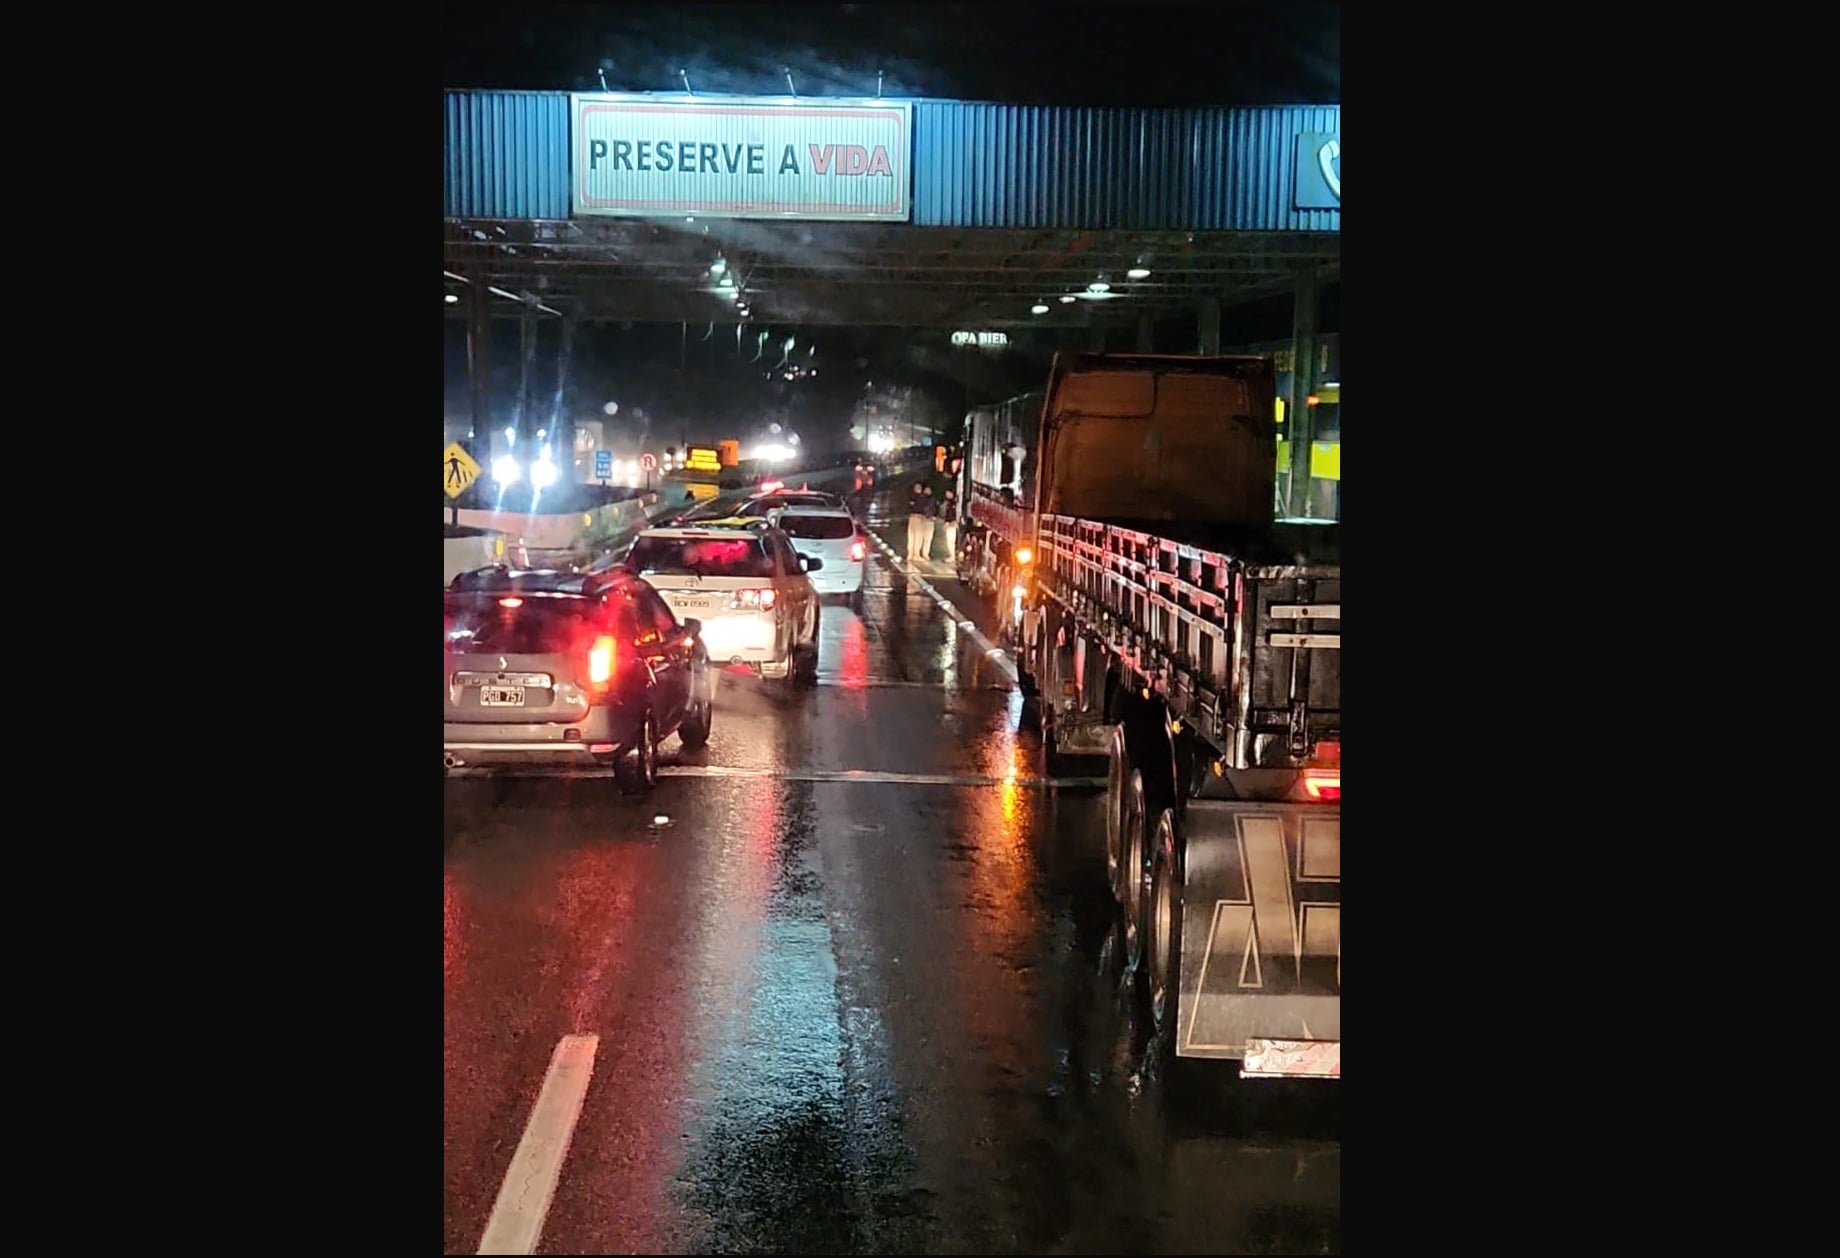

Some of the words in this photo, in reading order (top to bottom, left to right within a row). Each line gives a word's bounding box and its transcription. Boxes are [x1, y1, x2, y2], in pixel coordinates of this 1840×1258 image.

[590, 139, 764, 174] PRESERVE
[778, 144, 801, 175] A
[809, 143, 893, 177] VIDA
[978, 331, 1008, 345] BIER
[506, 690, 523, 703] 757
